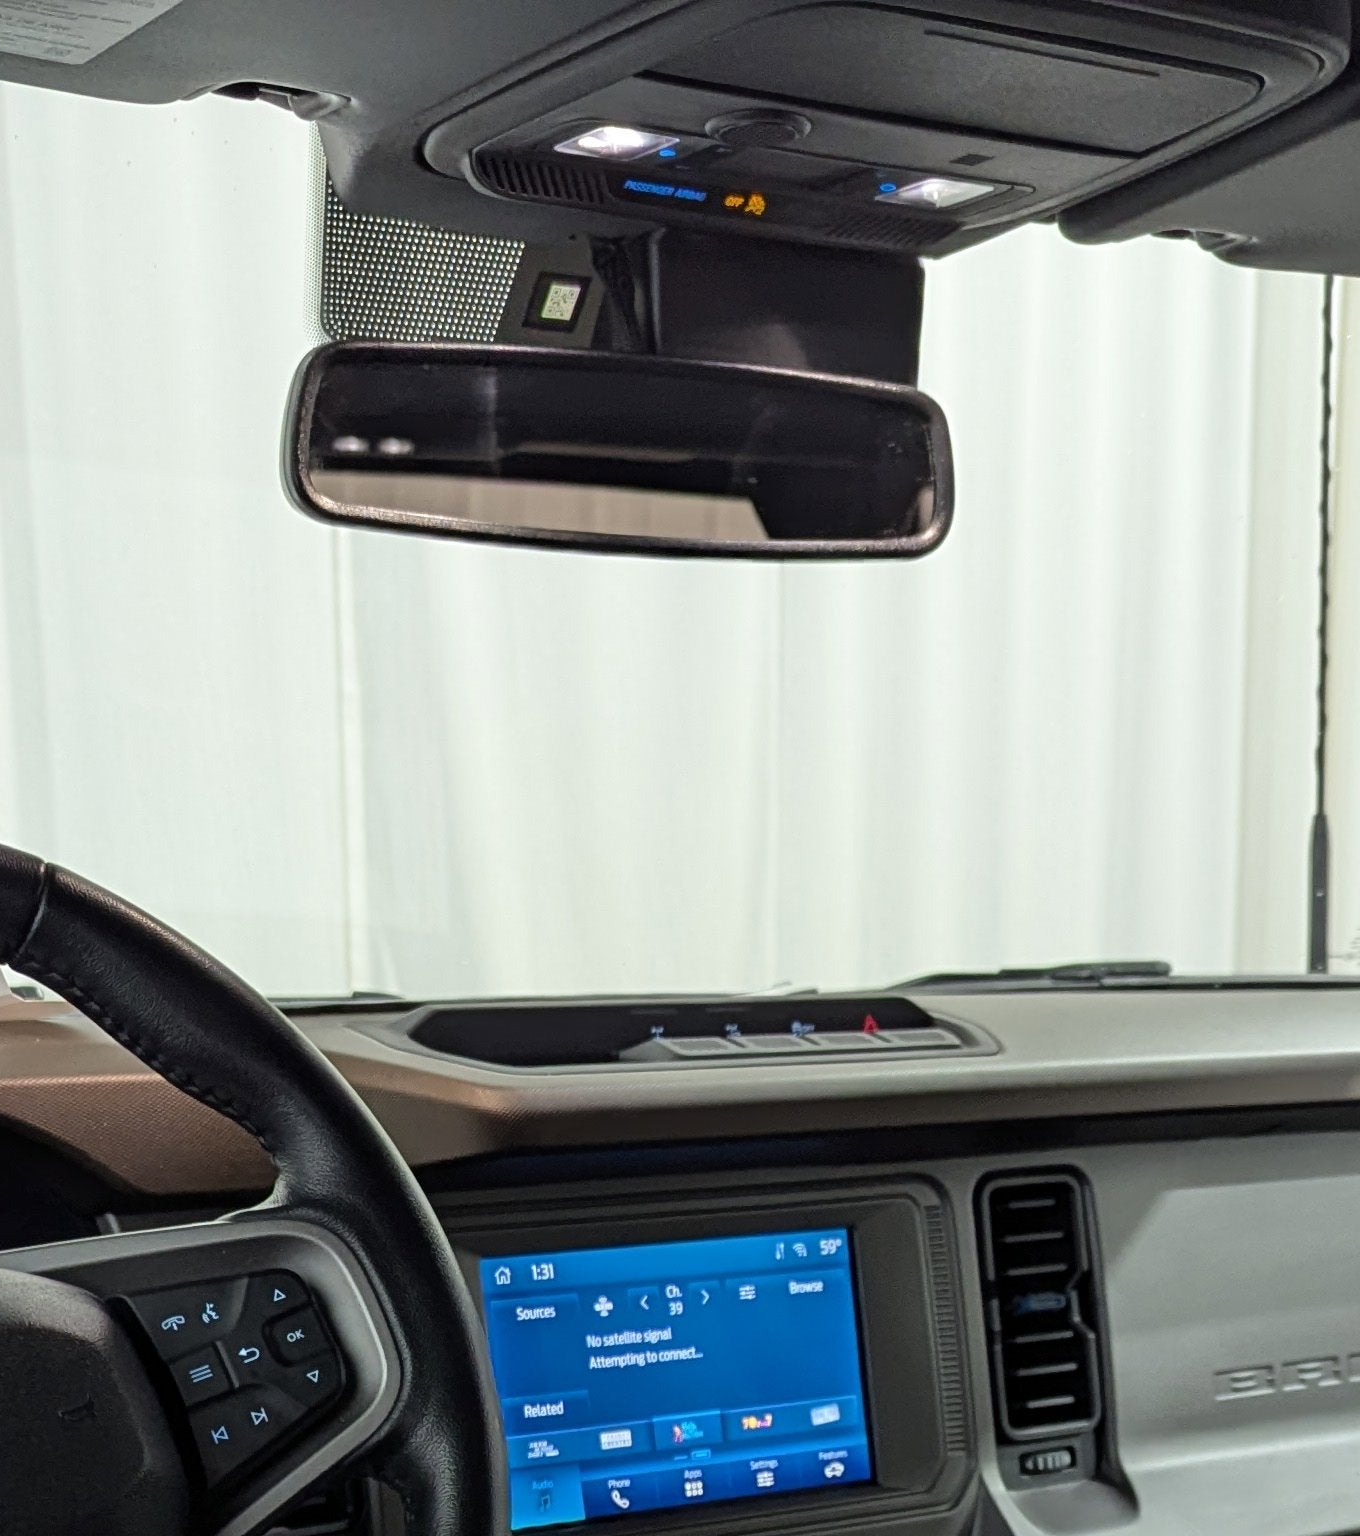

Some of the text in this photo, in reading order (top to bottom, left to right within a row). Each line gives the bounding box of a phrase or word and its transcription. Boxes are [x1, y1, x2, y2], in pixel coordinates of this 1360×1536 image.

[530, 1263, 554, 1281] 1:31
[788, 1279, 824, 1295] Browse
[516, 1305, 557, 1322] Sources
[668, 1300, 685, 1316] 39
[286, 1328, 306, 1343] OK
[585, 1326, 673, 1349] No satellite signal
[589, 1350, 646, 1370] Attempting
[646, 1350, 658, 1363] to
[524, 1400, 565, 1419] Related
[818, 1449, 849, 1461] Features
[750, 1459, 779, 1472] Settings
[684, 1469, 702, 1480] Apps
[532, 1480, 554, 1491] Audio
[607, 1479, 631, 1490] Phone
